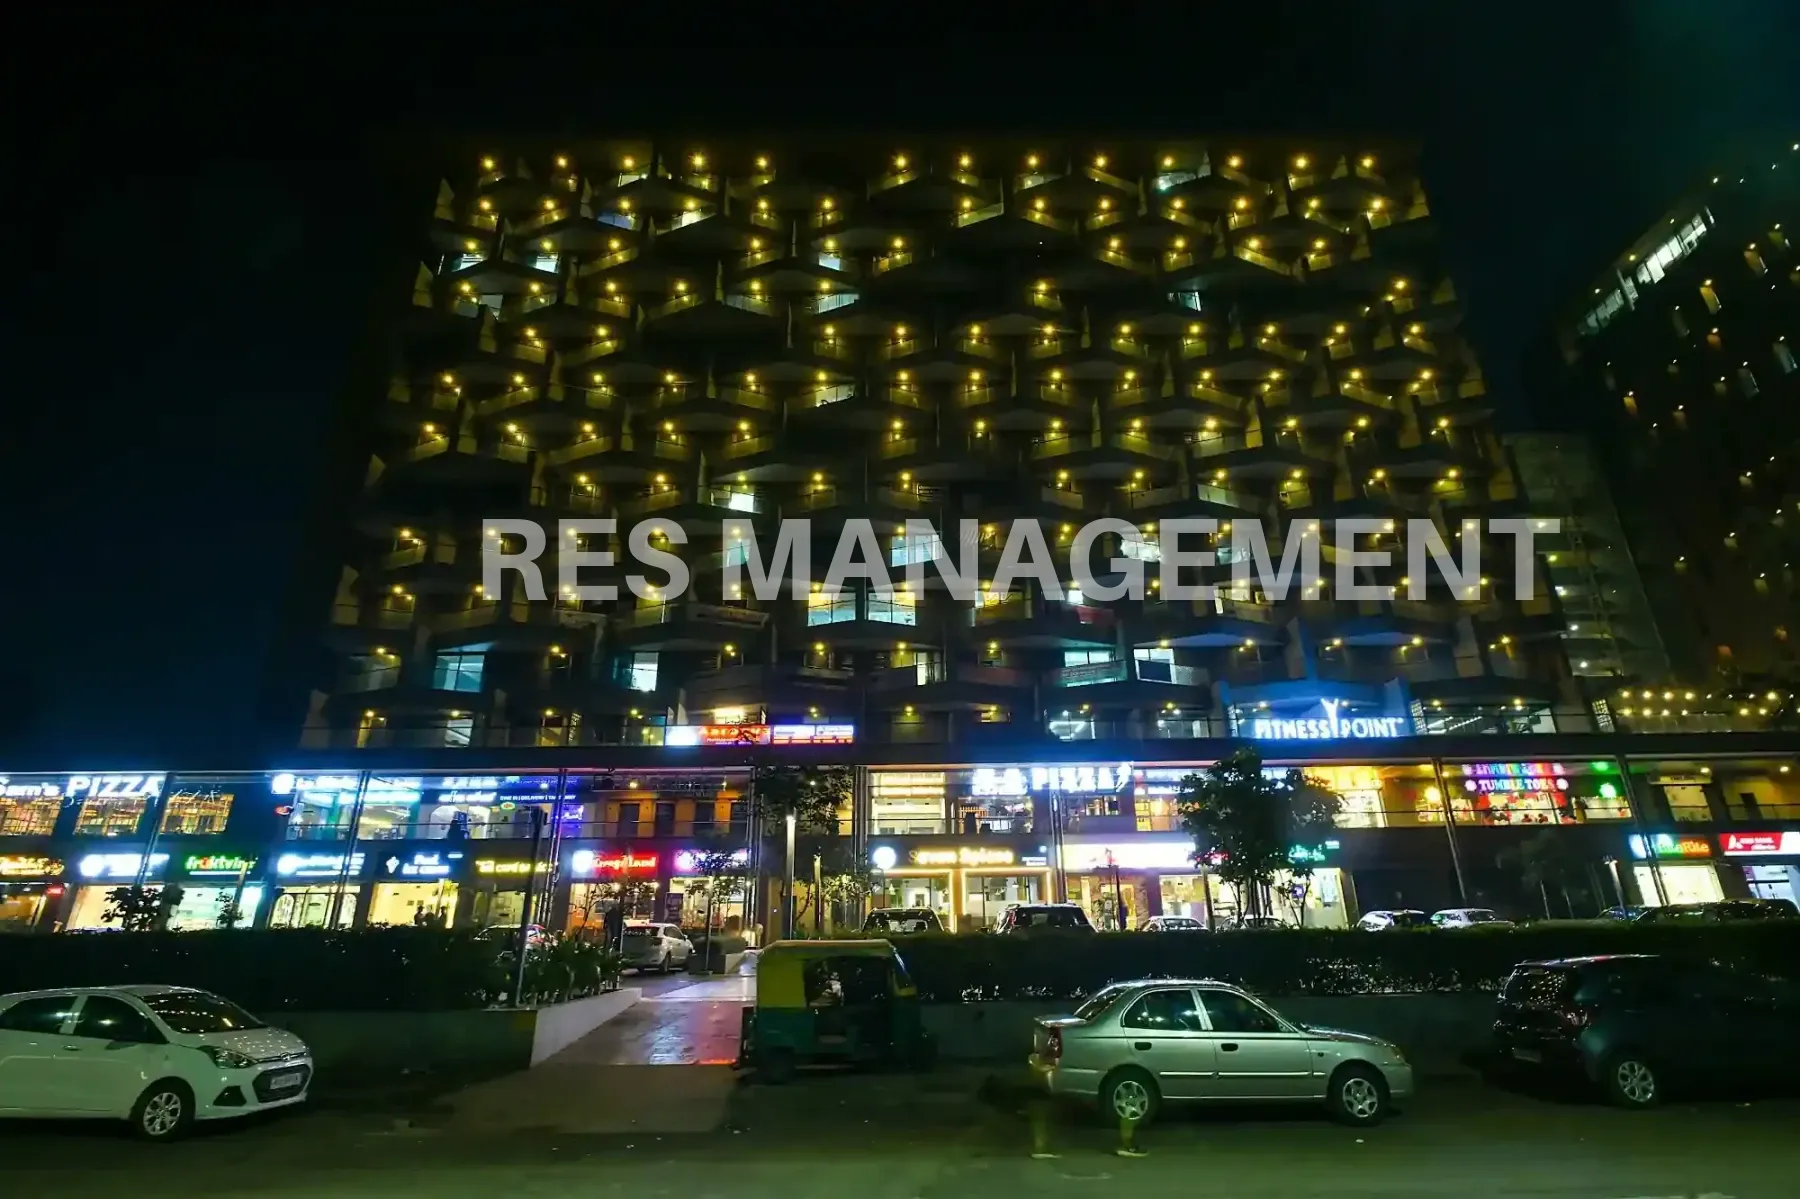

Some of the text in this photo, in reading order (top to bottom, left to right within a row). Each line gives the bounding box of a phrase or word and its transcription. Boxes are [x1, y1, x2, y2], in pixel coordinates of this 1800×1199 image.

[1254, 717, 1397, 739] FITNESS POINT
[65, 775, 165, 798] PIZZA
